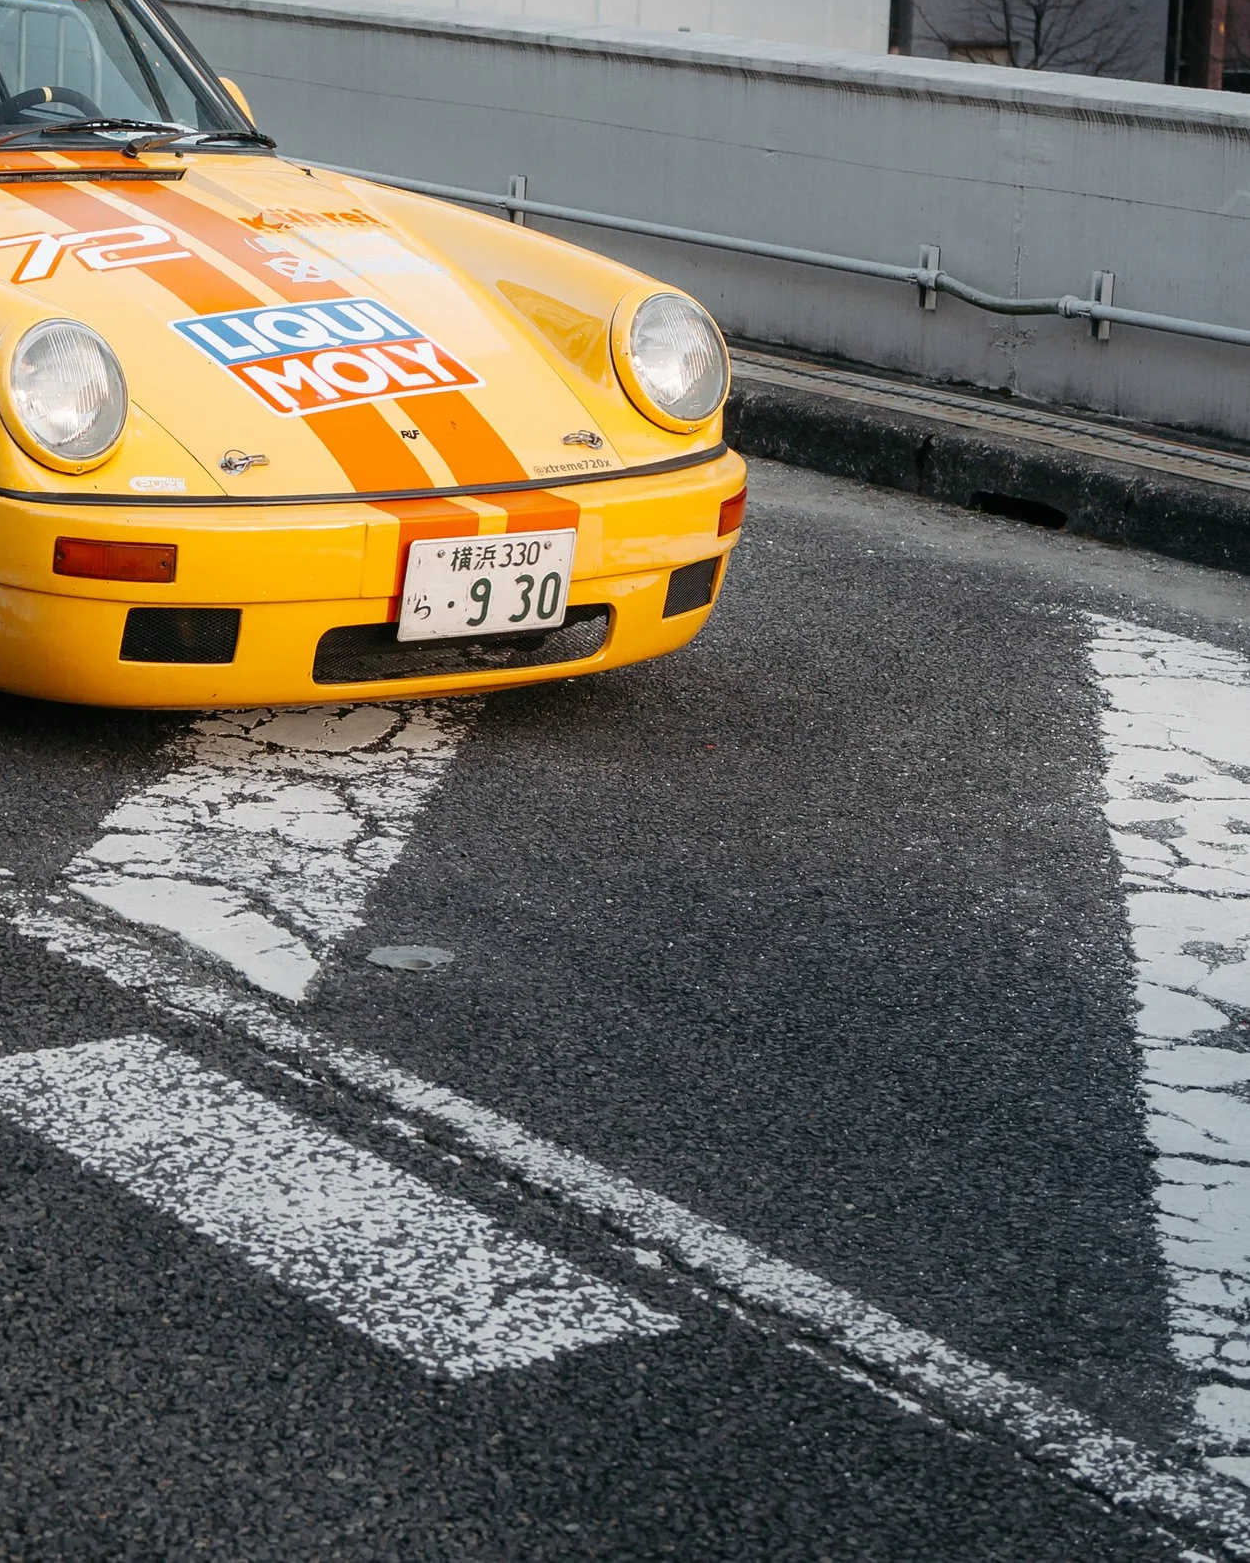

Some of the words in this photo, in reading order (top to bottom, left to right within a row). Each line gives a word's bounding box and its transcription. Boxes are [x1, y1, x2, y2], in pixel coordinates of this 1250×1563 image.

[186, 302, 412, 361] LIQUI
[241, 341, 458, 410] MOLY
[400, 429, 420, 440] RUF
[532, 458, 613, 477] @xtreme720x
